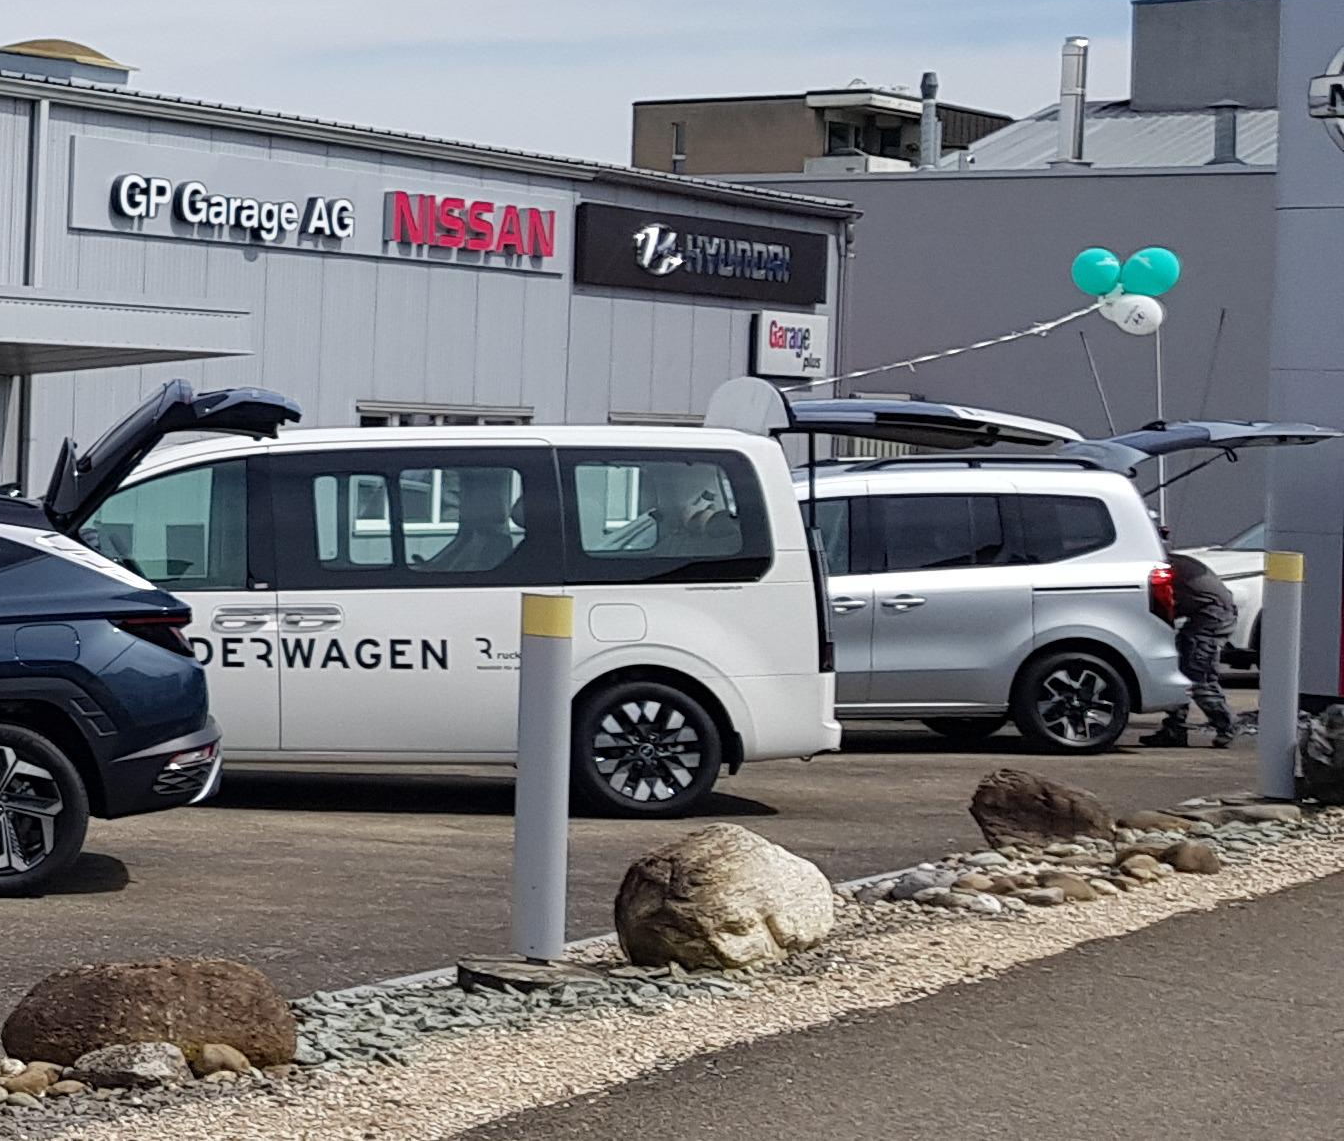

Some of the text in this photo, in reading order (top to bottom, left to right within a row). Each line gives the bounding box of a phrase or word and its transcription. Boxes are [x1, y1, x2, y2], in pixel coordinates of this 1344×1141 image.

[119, 174, 355, 241] GP Garage AG
[393, 190, 556, 258] NISSAN
[685, 234, 792, 284] HYUNDAI
[769, 320, 811, 358] Garage
[802, 350, 821, 371] plus
